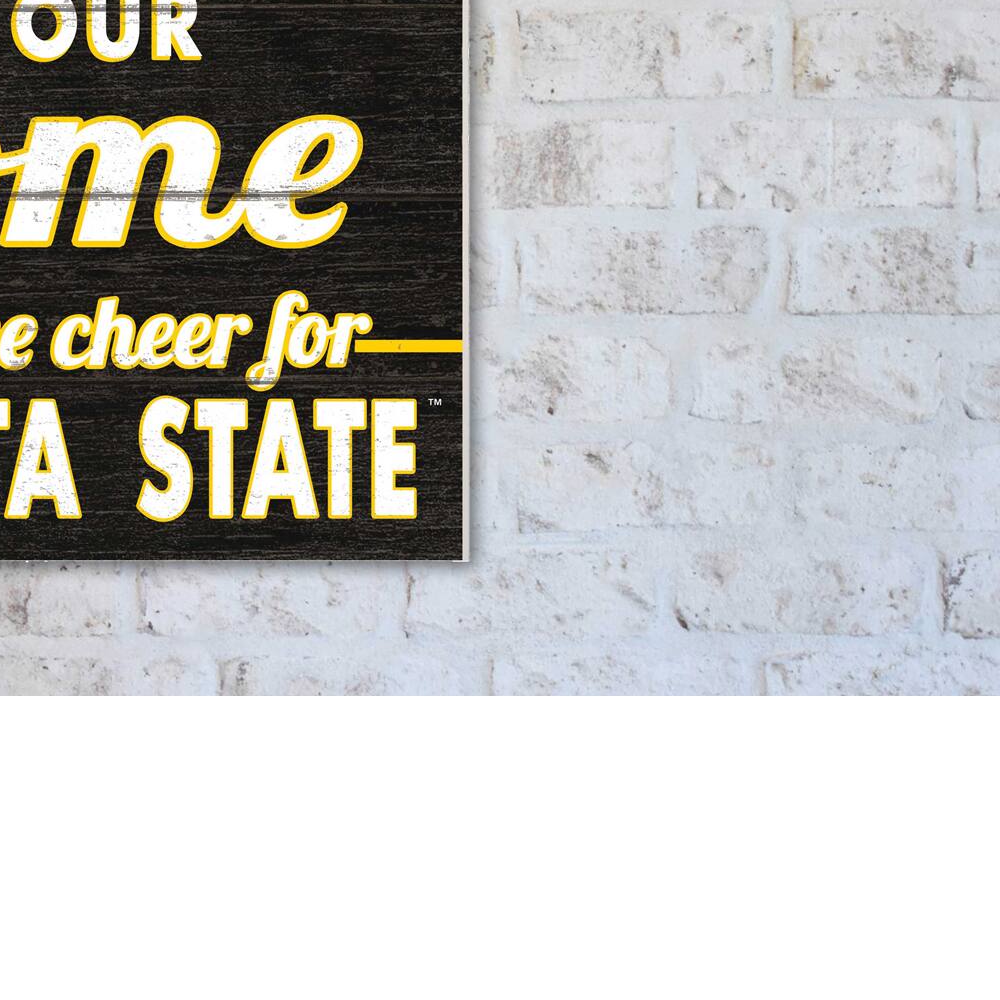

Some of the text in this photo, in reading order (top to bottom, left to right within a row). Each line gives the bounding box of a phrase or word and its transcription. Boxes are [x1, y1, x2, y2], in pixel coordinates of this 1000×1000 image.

[50, 295, 252, 372] cheer
[245, 289, 373, 392] for
[136, 395, 417, 522] STATE
